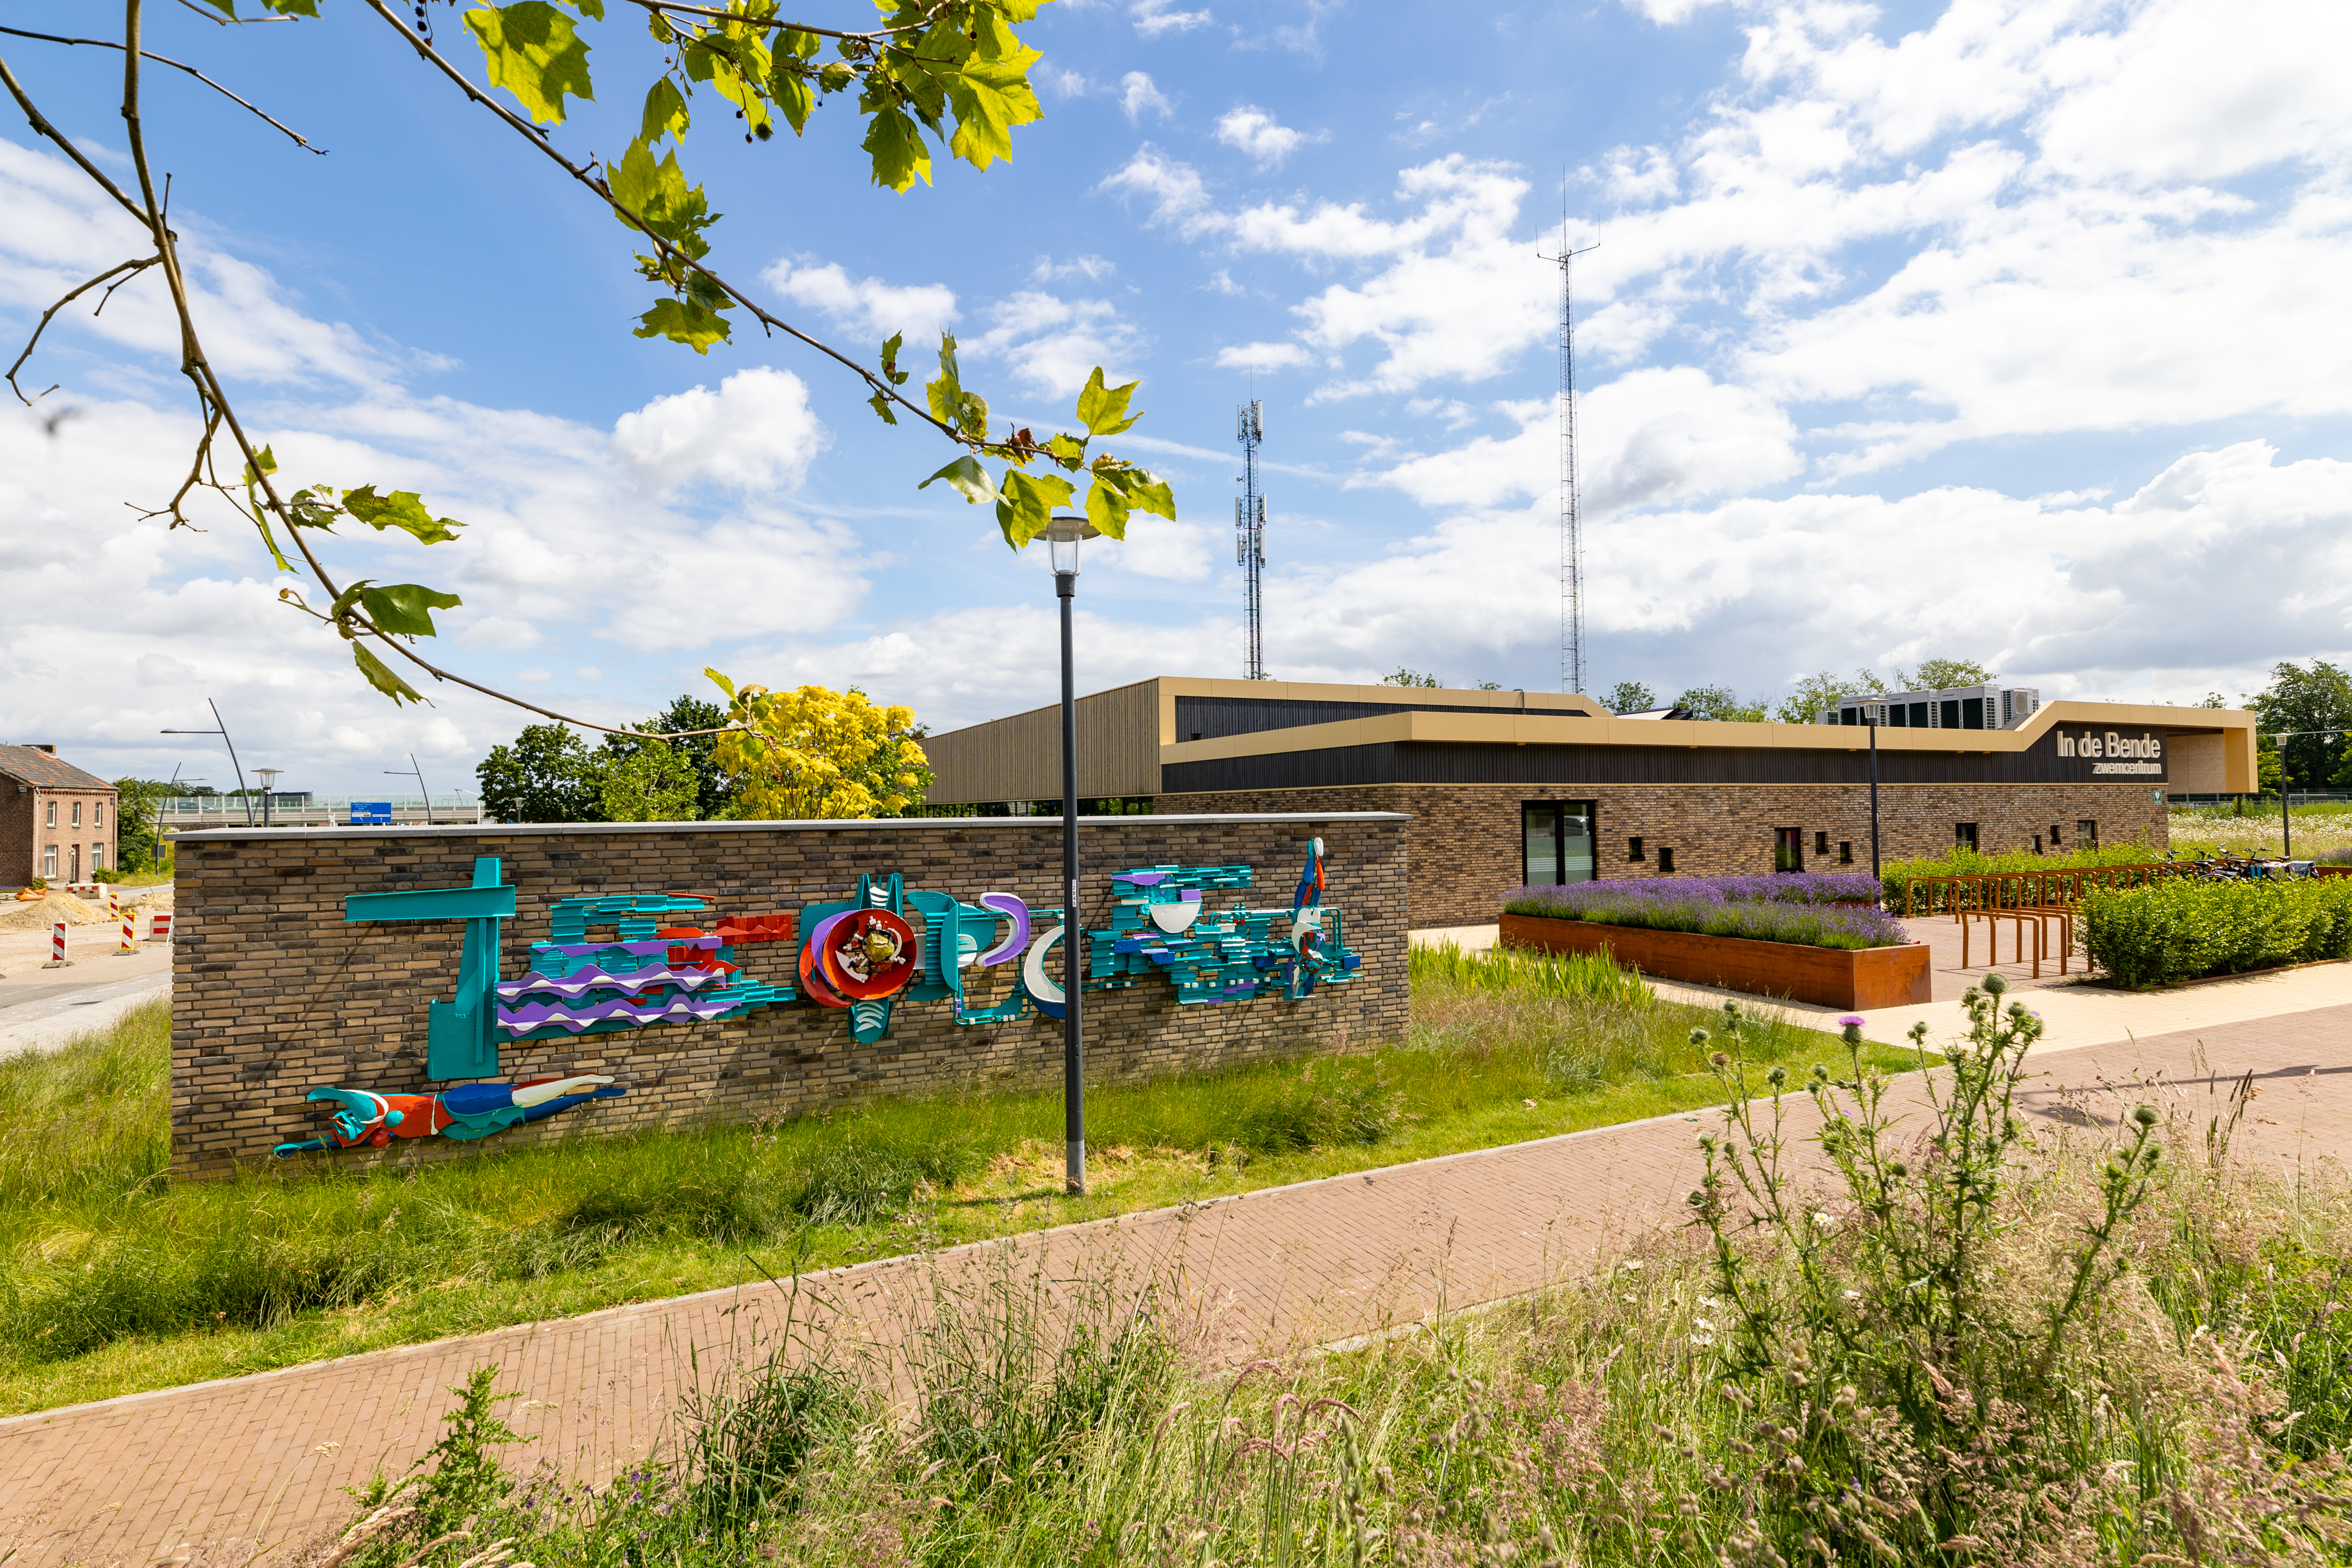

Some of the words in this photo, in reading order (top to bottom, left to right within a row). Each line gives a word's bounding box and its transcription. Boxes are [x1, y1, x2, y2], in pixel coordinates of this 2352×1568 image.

[2057, 731, 2075, 757] In
[2077, 731, 2103, 757] de
[2105, 732, 2161, 758] Bende
[2092, 760, 2162, 774] zwemcentrum
